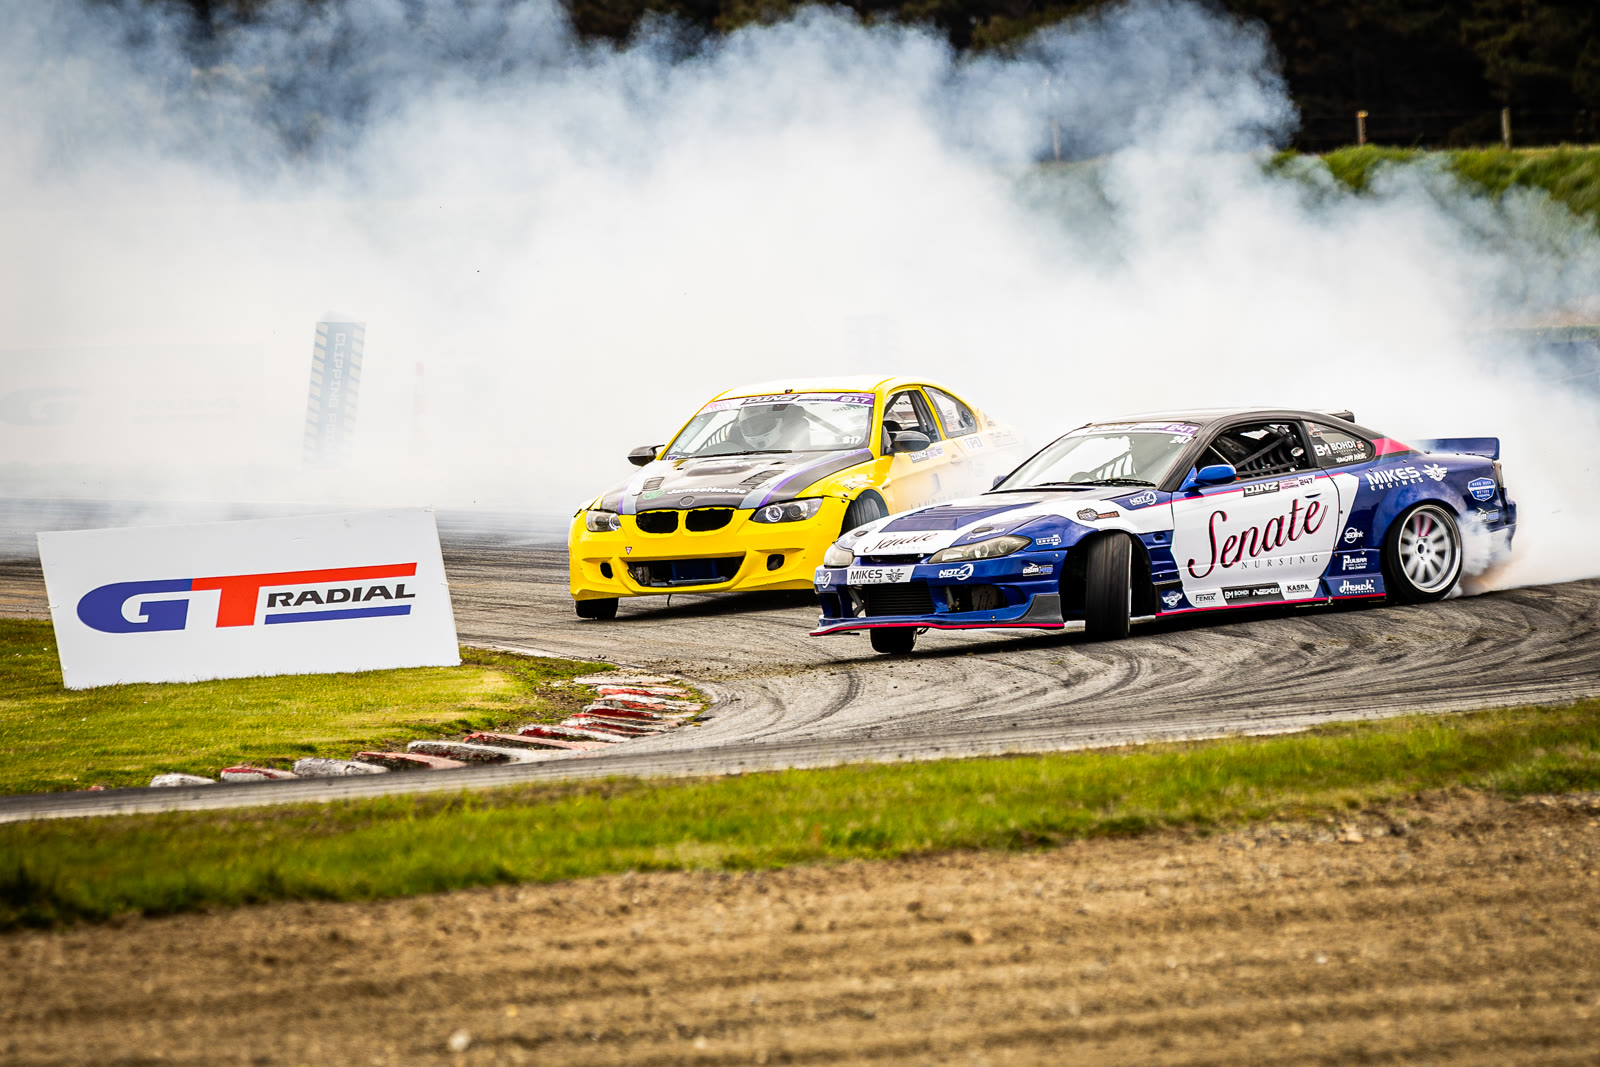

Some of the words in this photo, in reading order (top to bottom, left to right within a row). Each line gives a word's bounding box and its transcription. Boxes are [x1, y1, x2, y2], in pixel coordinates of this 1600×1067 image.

[328, 332, 346, 409] CLIPPING
[1330, 441, 1357, 451] BOHDI
[1298, 478, 1313, 486] 247
[1364, 466, 1421, 485] MIKES
[1370, 477, 1424, 491] ENGINES
[1187, 499, 1328, 579] Senate
[1241, 554, 1319, 570] NURSING
[850, 569, 883, 580] MIKES
[1286, 583, 1310, 592] KASPA
[266, 583, 416, 608] RADIAL
[1195, 592, 1217, 602] FENIX
